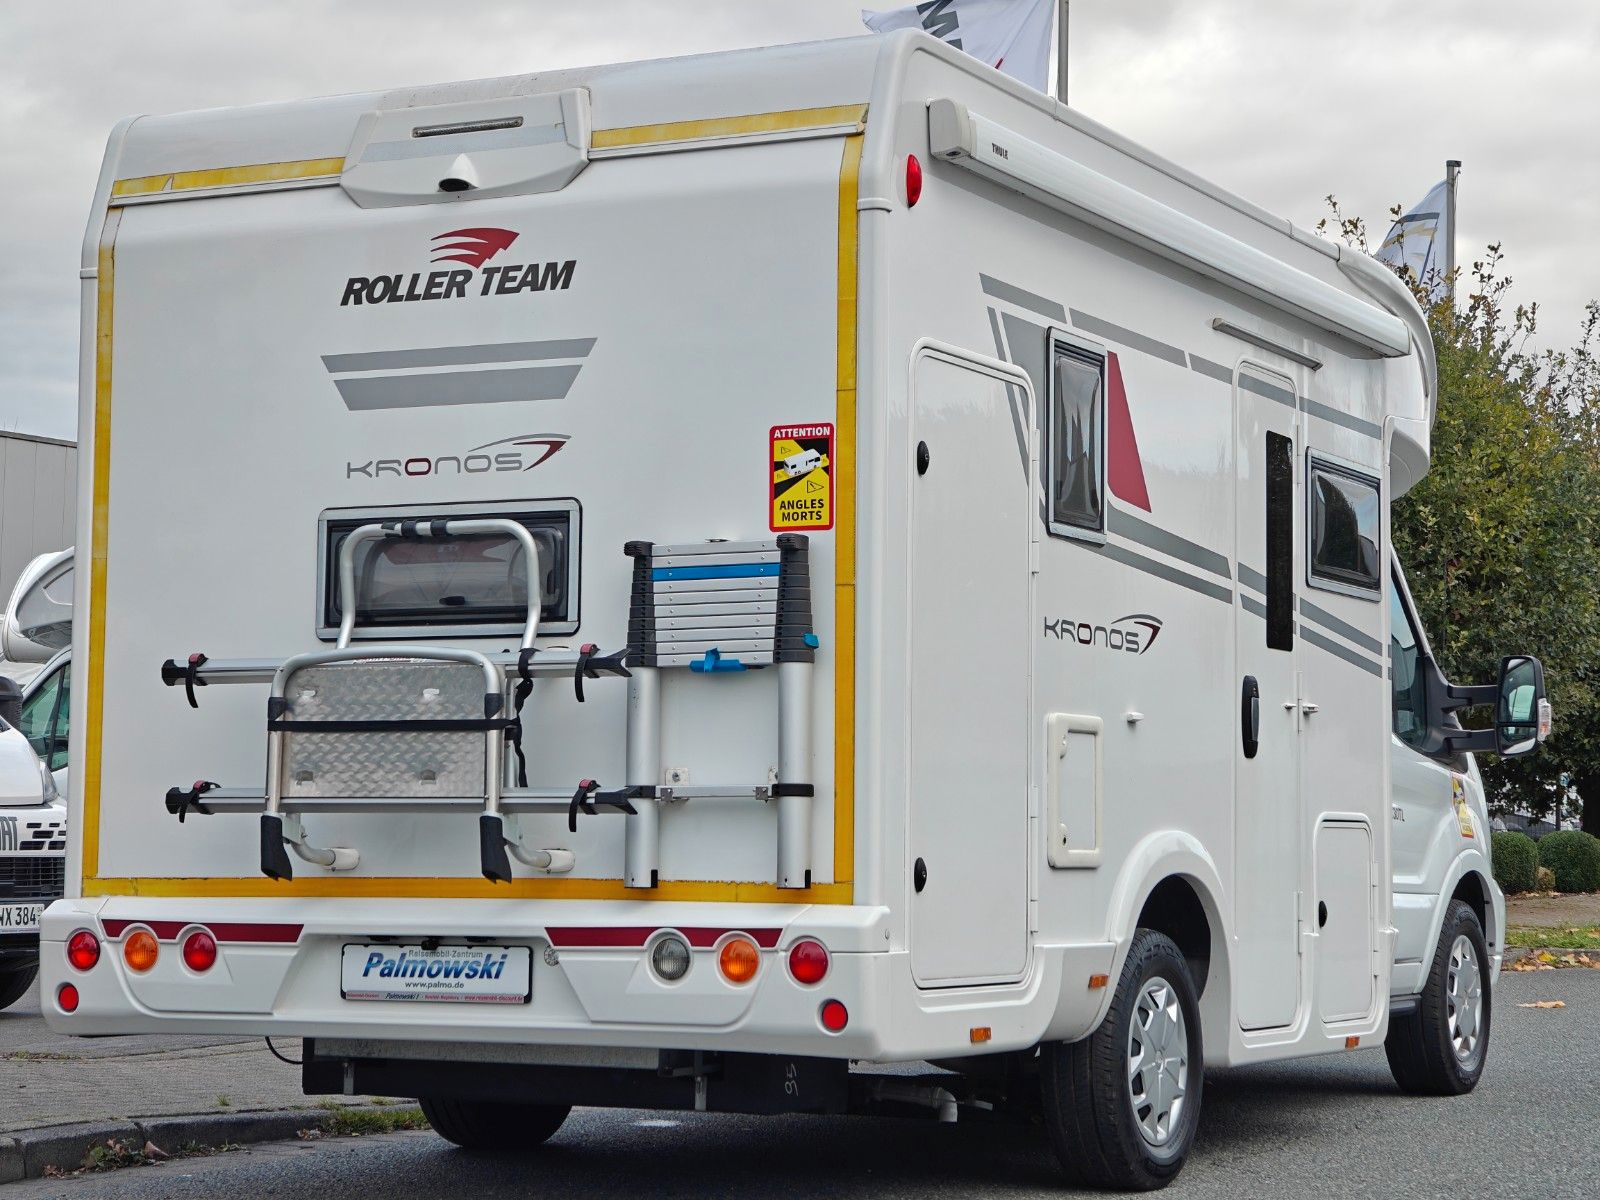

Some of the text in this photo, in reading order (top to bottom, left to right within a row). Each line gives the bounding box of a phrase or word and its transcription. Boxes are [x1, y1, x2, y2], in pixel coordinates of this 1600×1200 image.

[340, 260, 577, 306] ROLLER TEAM
[774, 426, 830, 439] ATTENTION
[779, 499, 825, 510] ANGLES
[782, 510, 823, 522] MORTS
[0, 816, 18, 851] AT
[15, 906, 36, 925] 384
[408, 949, 483, 959] Reisemobil-Zentrum
[363, 951, 508, 980] Palmowski
[405, 981, 465, 989] www.palmo.de
